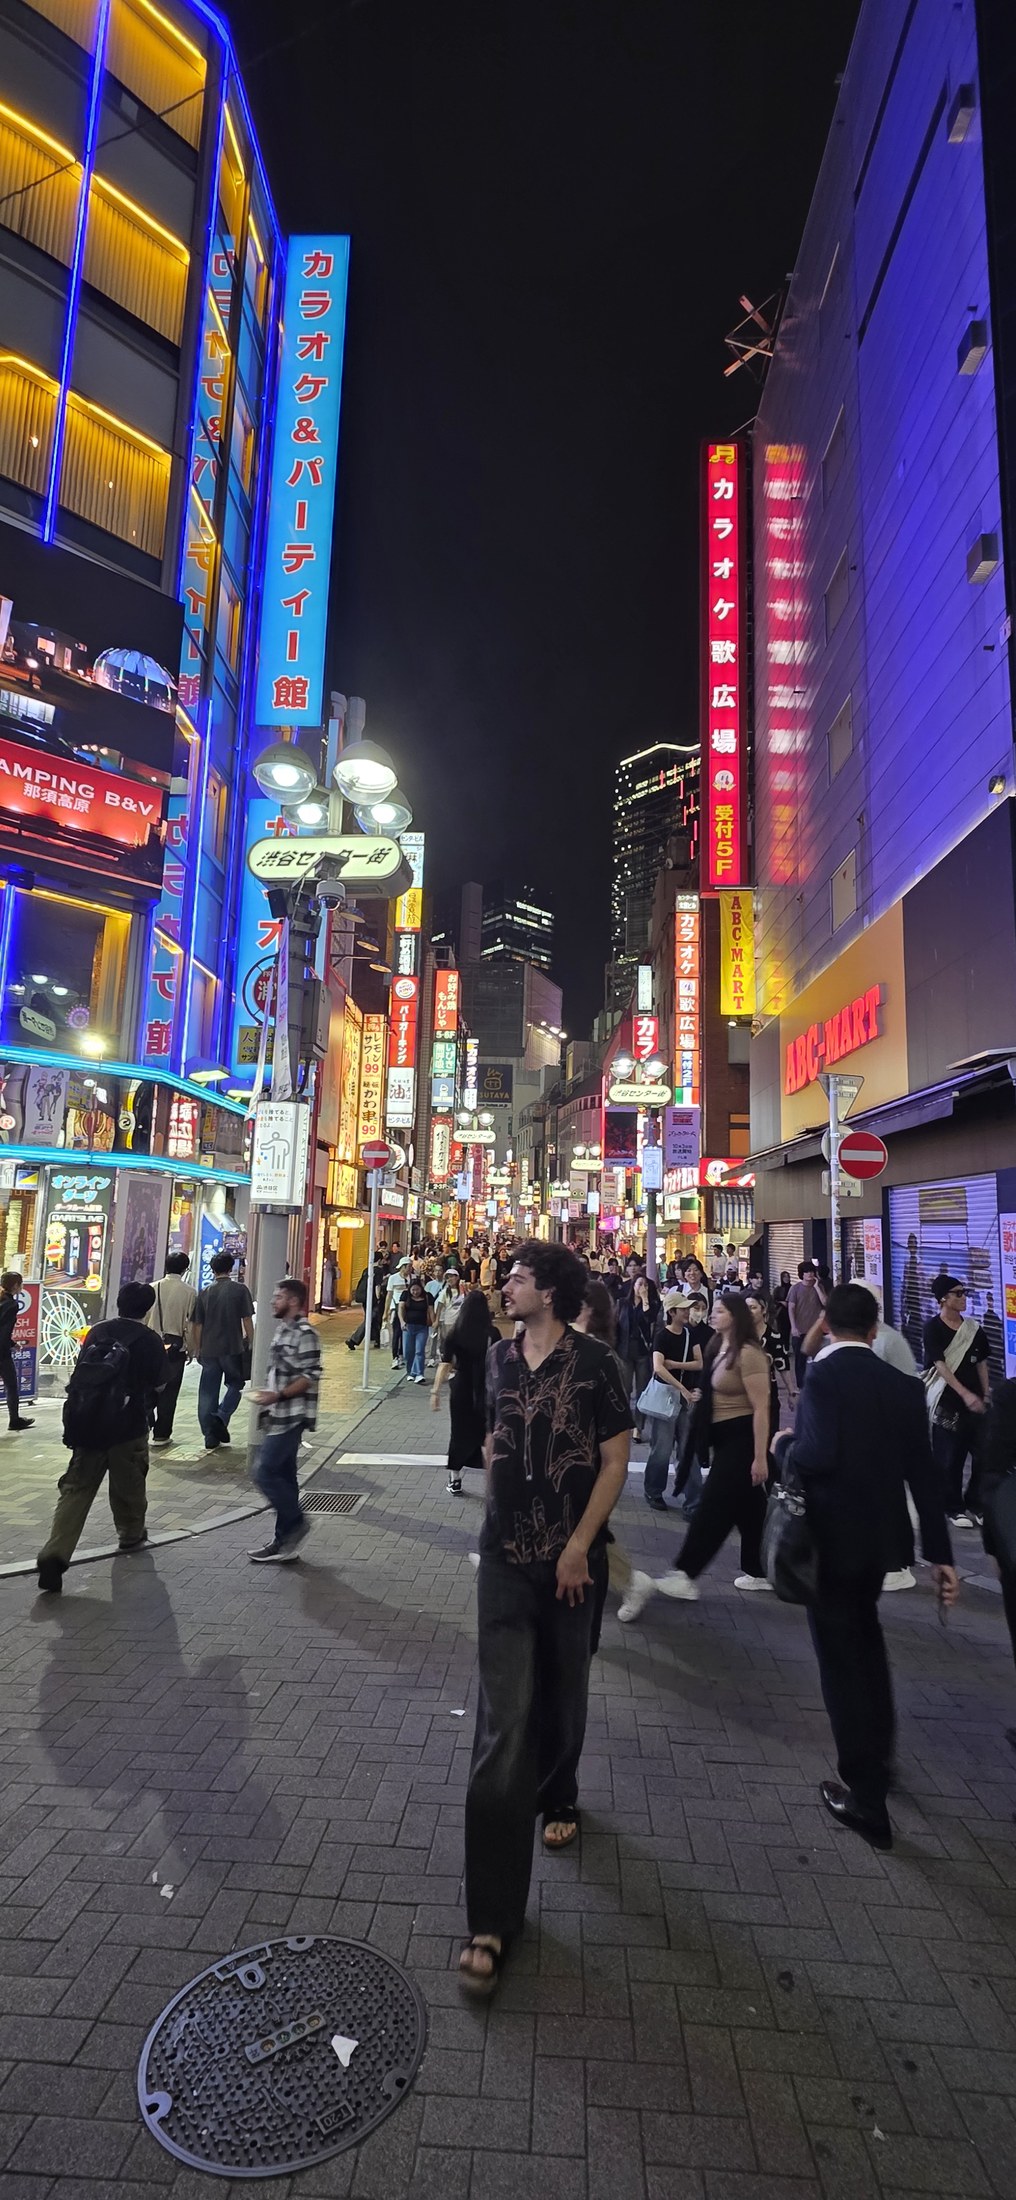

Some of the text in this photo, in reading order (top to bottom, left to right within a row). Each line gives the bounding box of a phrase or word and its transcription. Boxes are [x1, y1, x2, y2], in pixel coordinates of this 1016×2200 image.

[273, 250, 334, 710] カラオケ&パーティー館
[711, 477, 737, 754] カラオケ歌広場
[23, 782, 91, 814] 那須高原
[105, 791, 154, 816] B&V
[715, 804, 734, 876] 受付5F
[256, 847, 392, 868] 渋谷セー街
[731, 896, 744, 1010] ABC-MART
[397, 1005, 410, 1065] バーガーキング
[784, 984, 880, 1096] ABC-MART
[365, 1063, 379, 1074] 99
[361, 1125, 377, 1135] 99
[51, 1175, 111, 1190] オンライン
[62, 1189, 98, 1203] ダーツ
[323, 2107, 349, 2127] T-20
